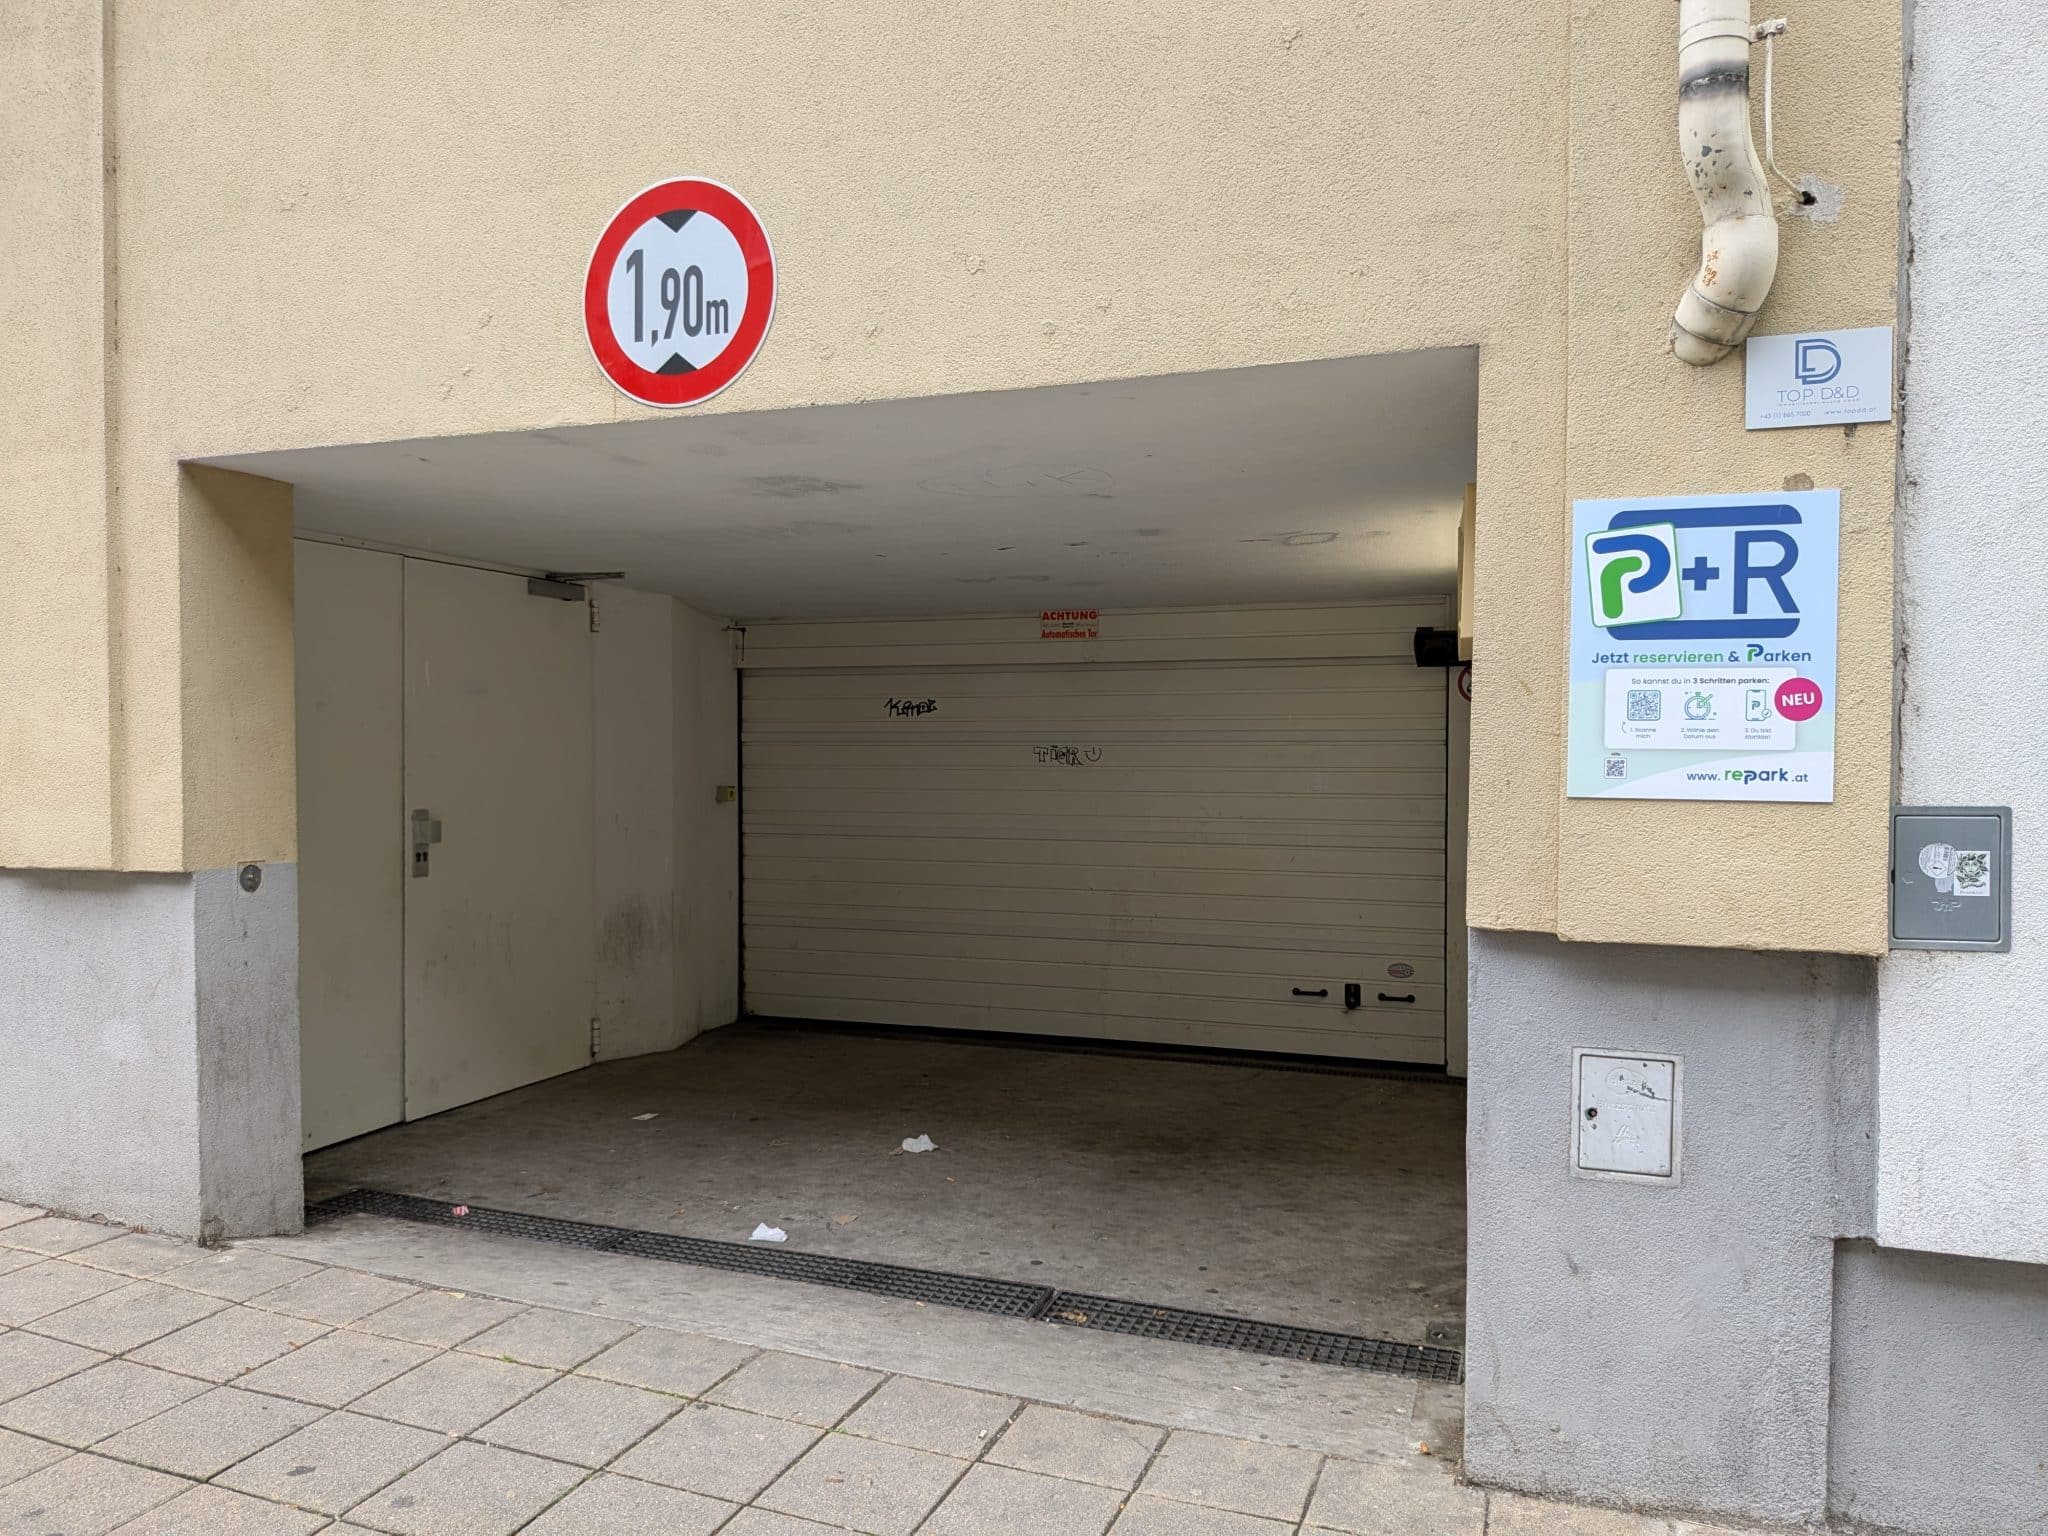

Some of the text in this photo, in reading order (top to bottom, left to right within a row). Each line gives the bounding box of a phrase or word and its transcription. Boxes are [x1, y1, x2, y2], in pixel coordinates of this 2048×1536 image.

[626, 249, 729, 347] 1,90m
[1776, 385, 1860, 402] TOP D&D
[1042, 611, 1097, 620] ACHTUNG
[1042, 628, 1097, 638] Automatisches Tor
[1591, 643, 1812, 664] Jetzt reservieren & Parken
[1738, 677, 1770, 686] parken:
[1781, 692, 1816, 707] NEU
